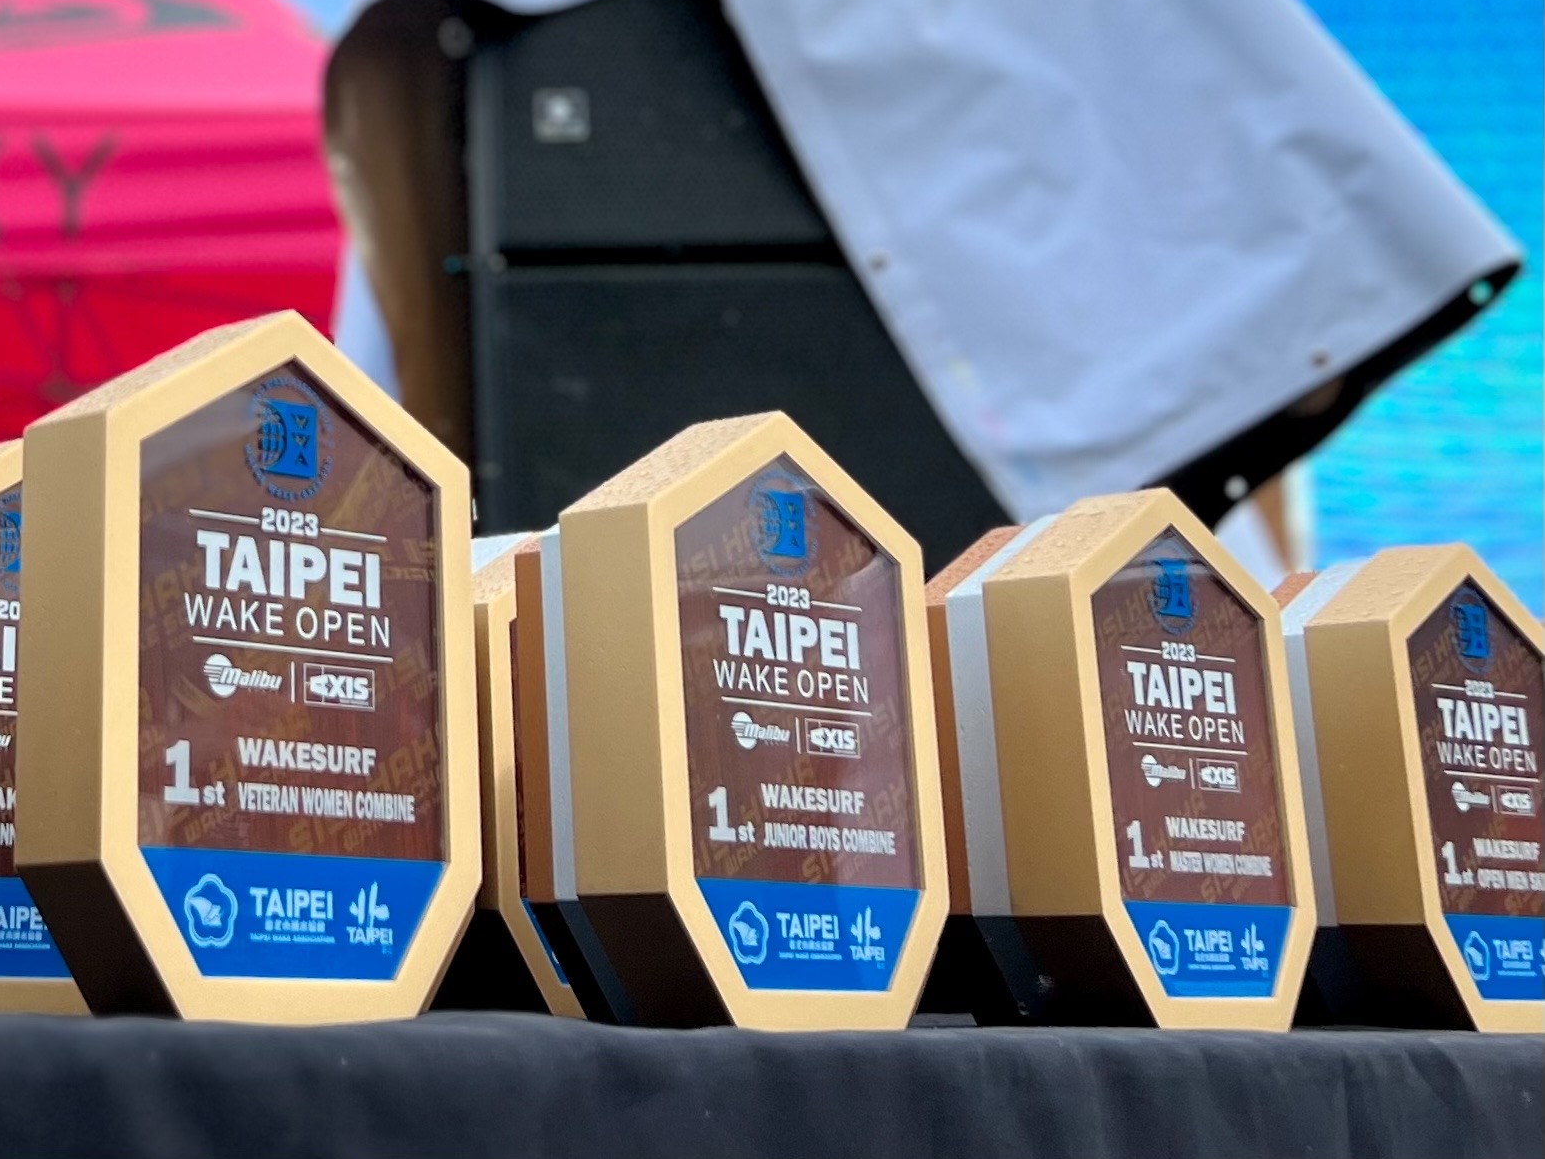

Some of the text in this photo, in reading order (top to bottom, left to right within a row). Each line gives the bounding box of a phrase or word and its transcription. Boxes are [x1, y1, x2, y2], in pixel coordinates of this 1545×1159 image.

[261, 507, 319, 538] 2023
[196, 529, 382, 609] TAIPEI
[766, 583, 811, 610] 2023
[184, 592, 391, 649] WAKE OPEN
[718, 604, 861, 670] TAIPEI
[1161, 641, 1197, 663] 2023
[712, 658, 869, 705] WAKE OPEN
[1126, 660, 1237, 715] TAIPEI
[1123, 709, 1245, 744] WAKE OPEN
[1436, 697, 1530, 746] TAIPEI
[237, 736, 377, 776] WAKESURF
[1436, 740, 1538, 773] WAKE OPEN
[237, 781, 417, 823] VETERAN WOMEN COMBINE
[760, 783, 865, 815] WAKESURF
[763, 822, 897, 855] JUNIOR BOYS COMBINE
[1165, 816, 1246, 842] WAKESURF
[249, 886, 334, 920] TAIPEI
[346, 926, 394, 946] TAIPEI
[775, 912, 840, 940] TAIPEI
[1184, 928, 1234, 953] TAIPEI
